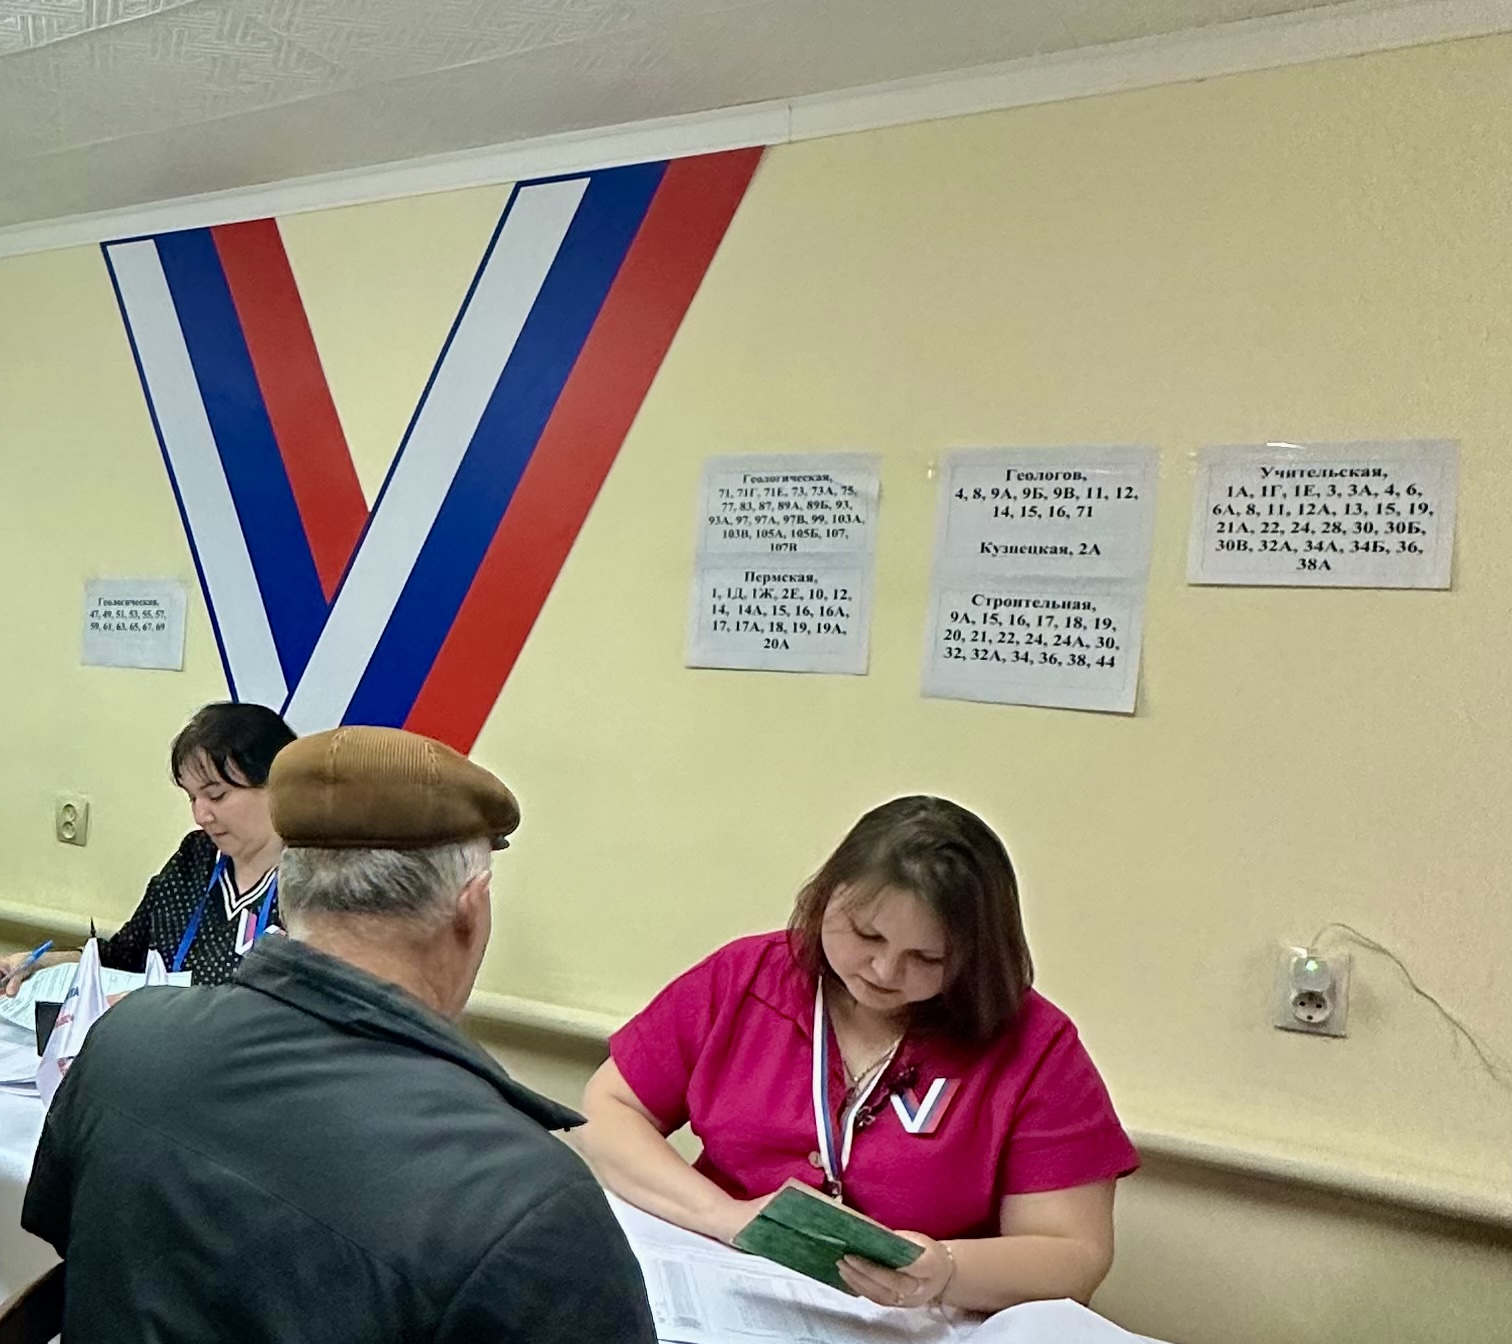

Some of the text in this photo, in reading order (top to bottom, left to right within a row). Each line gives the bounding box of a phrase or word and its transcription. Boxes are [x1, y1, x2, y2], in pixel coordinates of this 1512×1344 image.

[743, 474, 833, 484] Геологическая,
[1006, 469, 1087, 482] Геологов,
[1260, 467, 1388, 480] Учительская,
[955, 487, 1138, 501] 4, 8, 9А, 9Б, 9В, 11, 12,
[1228, 484, 1423, 499] 1А, 1Г, 1Е, 3, 3А, 4, 6,
[993, 506, 1093, 518] 14, 15, 16, 71
[1213, 503, 1434, 517] 6А, 8, 11, 12А, 13, 15, 19,
[1217, 522, 1426, 535] 21А, 22, 24, 28, 30, 30Б,
[980, 542, 1100, 557] Кузнецкая, 2А
[1215, 540, 1423, 554] 30В, 32А, 34А, 34Б, 36,
[1296, 559, 1331, 571] 38А
[745, 571, 818, 585] Пермская,
[712, 588, 722, 600] 1,
[753, 588, 778, 600] 1Ж,
[782, 588, 804, 601] 2Е,
[810, 589, 828, 601] 10,
[833, 589, 852, 601] 12,
[972, 594, 1096, 612] Строительная,
[712, 604, 850, 618] 14, 14А, 15, 16, 16А,
[713, 620, 847, 635] 17, 17А, 18, 19, 19А,
[951, 611, 1117, 632] 9А, 15, 16, 17, 18, 19,
[764, 638, 789, 650] 20А
[943, 629, 1120, 650] 20, 21, 22, 24, 24А, 30,
[943, 647, 1115, 668] 32, 32А, 34, 36, 38, 44
